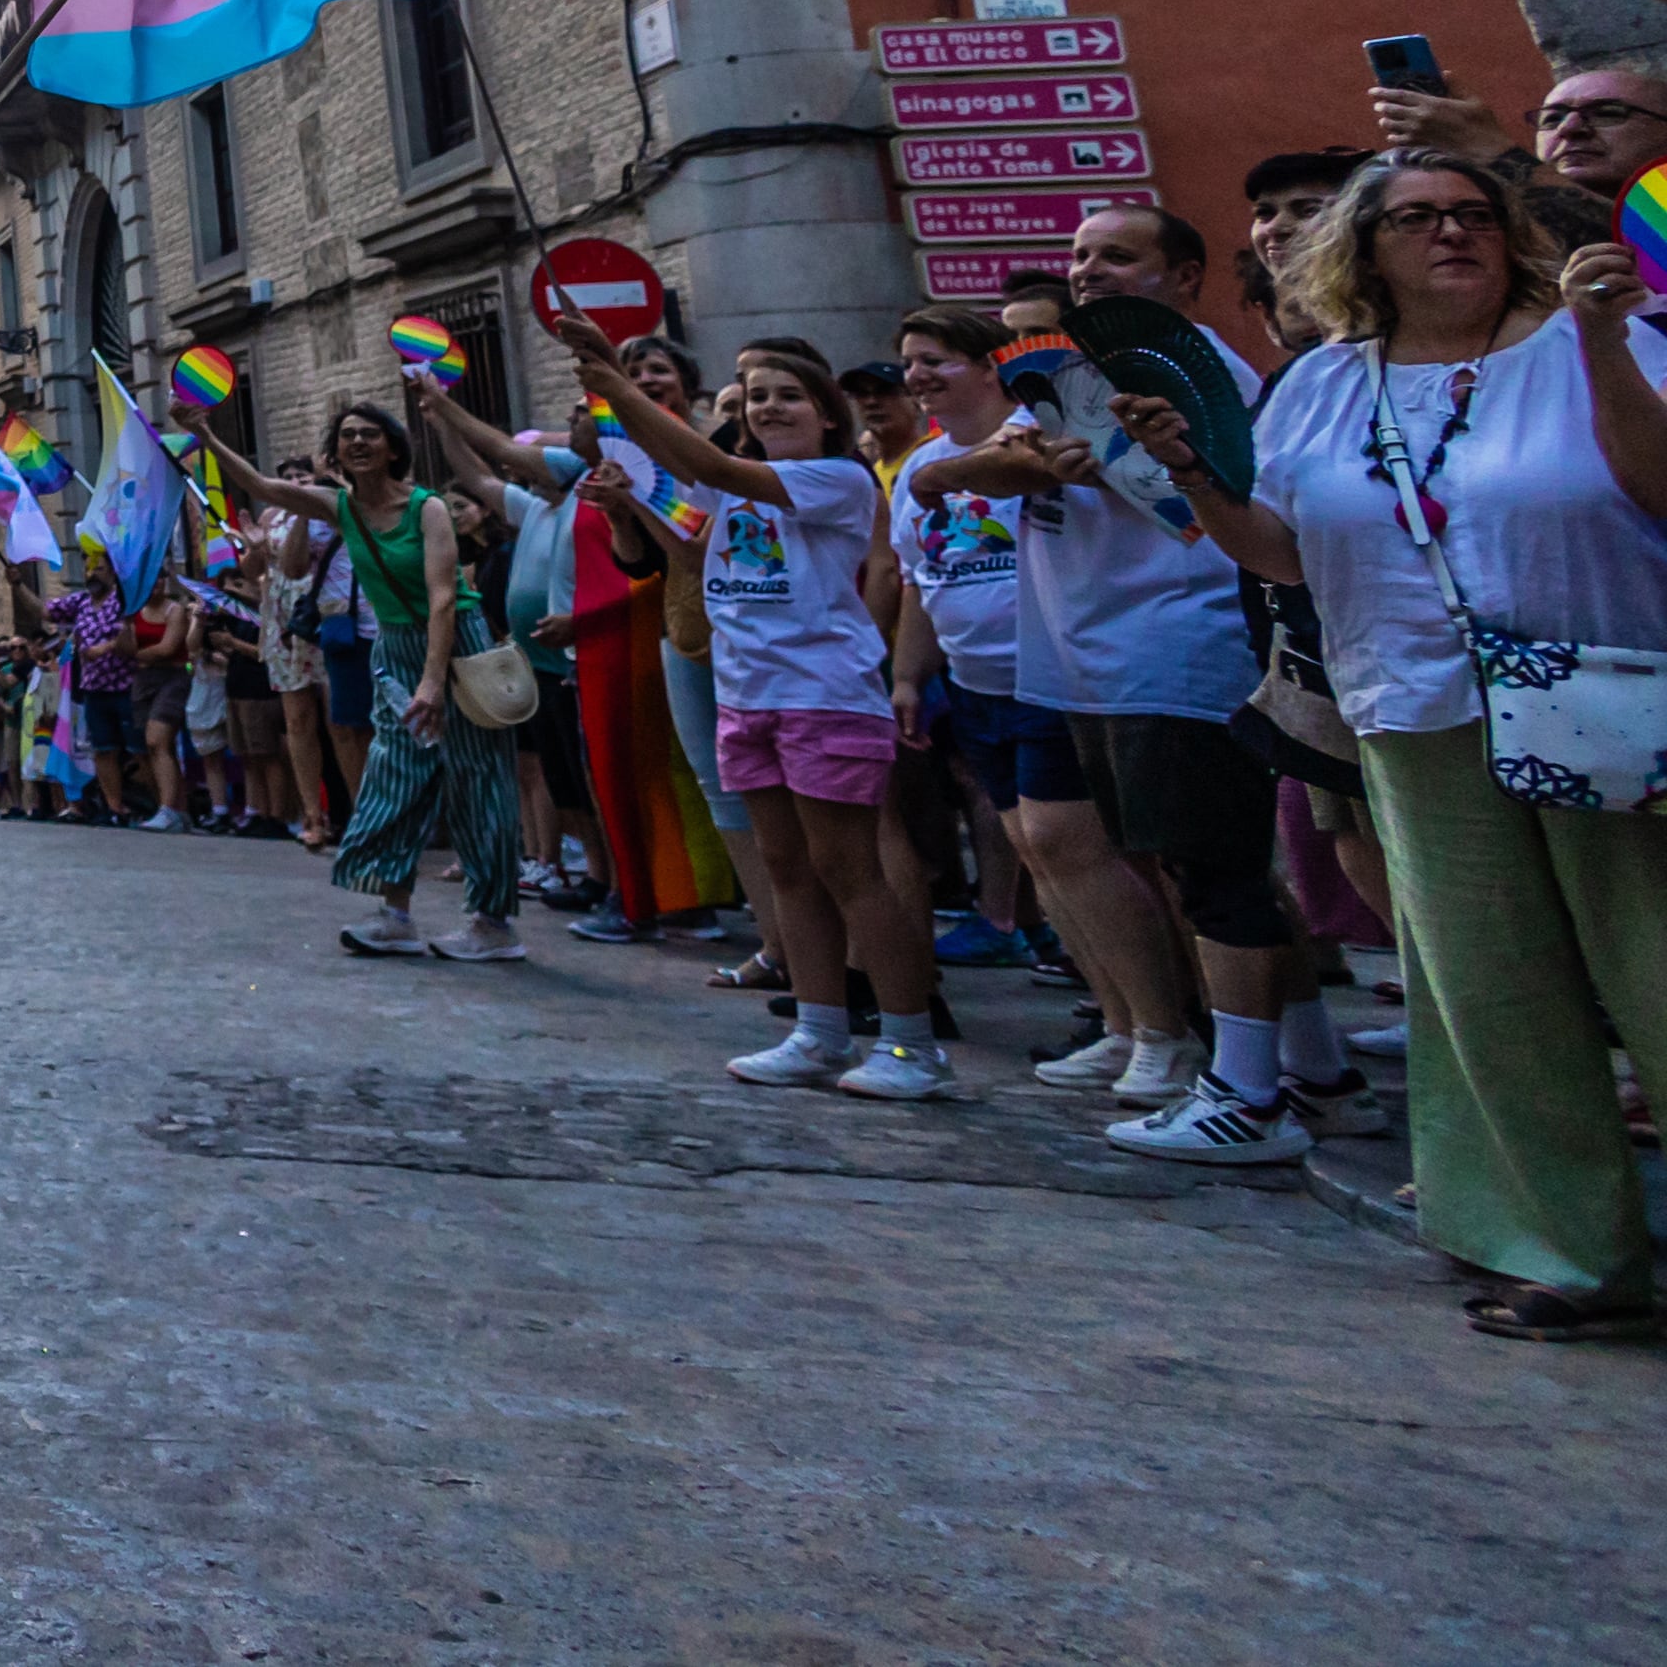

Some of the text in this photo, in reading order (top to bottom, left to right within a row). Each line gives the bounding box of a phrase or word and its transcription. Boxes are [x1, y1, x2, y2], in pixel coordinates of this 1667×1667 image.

[885, 29, 1025, 48] casa museo
[888, 45, 1028, 64] de El Greco
[899, 93, 1036, 115] sinagogas
[999, 142, 1029, 157] de
[910, 158, 1054, 178] Santo Tomé
[920, 201, 1016, 216] San Juan
[922, 215, 1056, 233] de los Reyes
[932, 261, 981, 274] casa
[989, 261, 1000, 274] y
